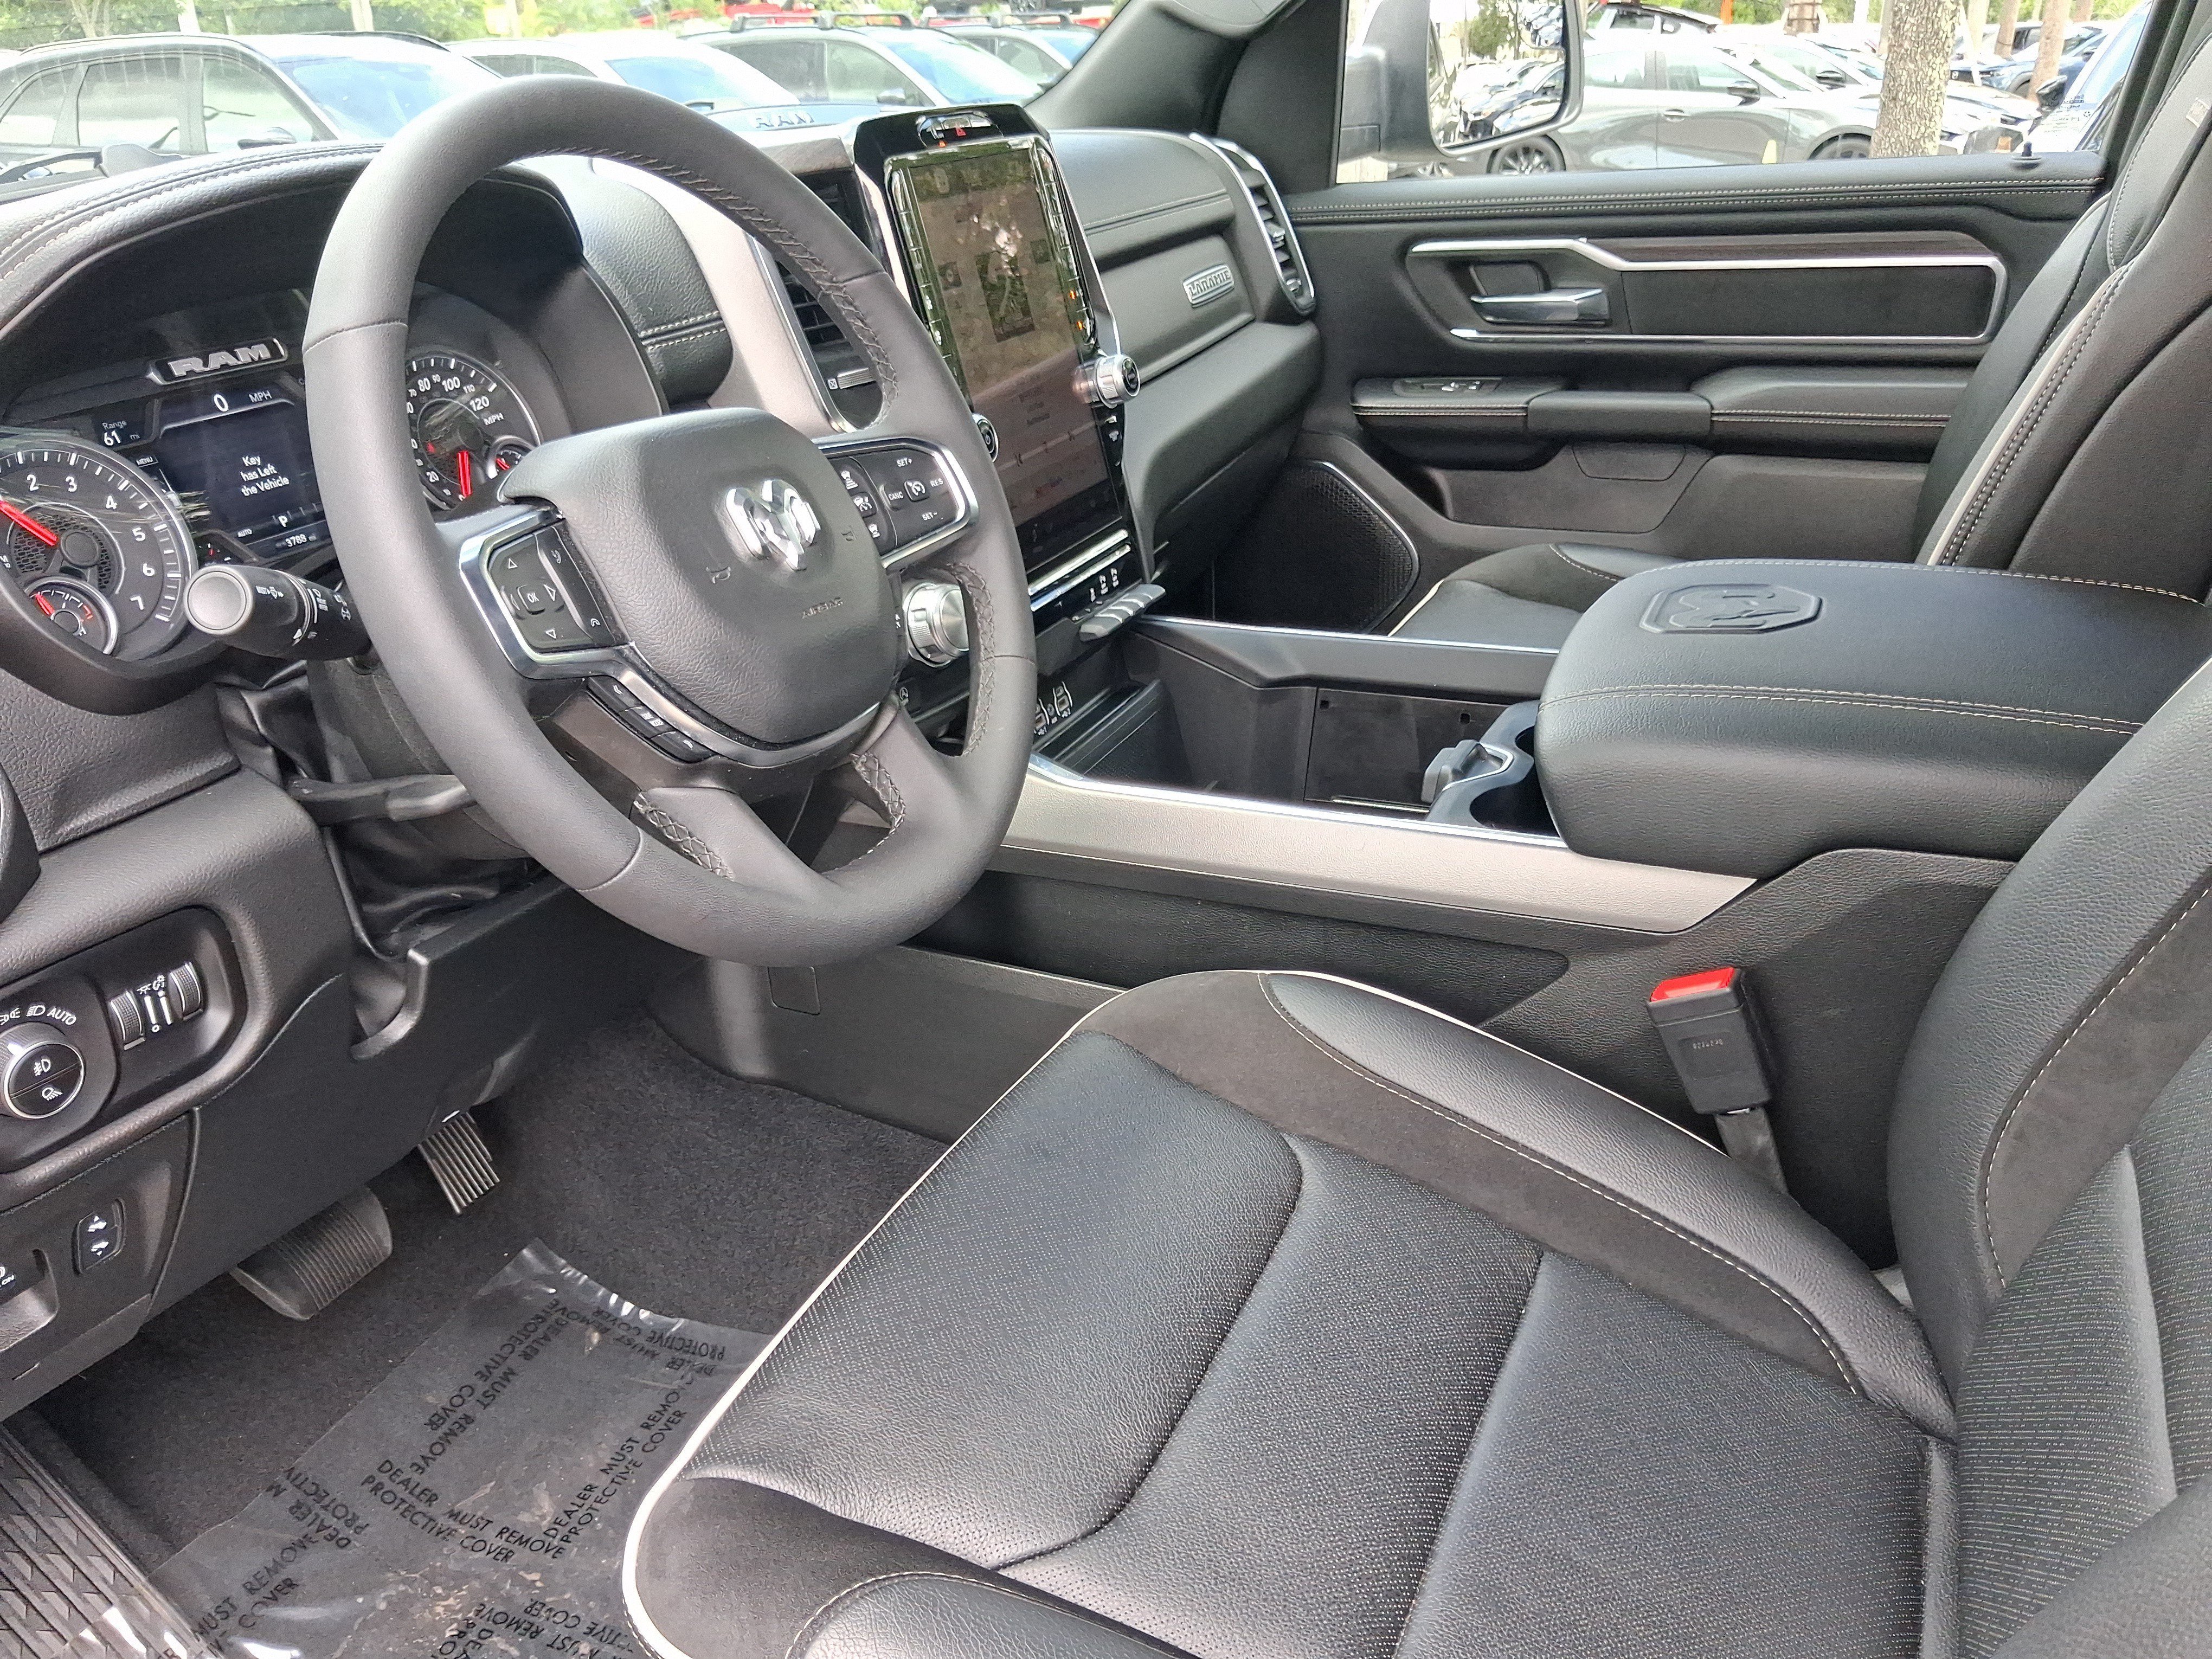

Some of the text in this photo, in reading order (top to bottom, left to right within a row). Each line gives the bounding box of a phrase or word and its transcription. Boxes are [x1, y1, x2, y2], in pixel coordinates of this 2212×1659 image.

[1188, 270, 1231, 295] LARAMIE
[167, 344, 271, 377] RAM
[417, 378, 431, 392] 80
[442, 376, 460, 391] 100
[463, 384, 475, 394] 110
[214, 390, 272, 412] 0 MPH
[470, 395, 490, 411] 120
[102, 420, 127, 430] Range
[484, 413, 504, 425] MPH
[104, 430, 121, 446] 61
[136, 456, 153, 466] MENU
[242, 455, 261, 467] Key
[240, 464, 278, 481] has Left
[426, 471, 439, 482] 20
[27, 474, 39, 491] 2
[66, 476, 78, 492] 3
[241, 476, 290, 496] the Vehicle
[930, 478, 943, 487] RES
[106, 496, 118, 510] 4
[889, 491, 903, 500] CANC
[278, 516, 288, 527] P
[132, 528, 146, 542] 5
[237, 529, 252, 537] AUTO
[143, 563, 155, 576] 6
[130, 596, 144, 610] 7
[528, 593, 539, 603] OK
[47, 1007, 77, 1026] AUTO
[645, 1329, 725, 1361] PROTECTIVE
[477, 1367, 518, 1410] MUST
[423, 1385, 474, 1431] COVER
[409, 1413, 475, 1476] REMOVE
[561, 1410, 687, 1544] PROTECTIVE COVER
[543, 1484, 598, 1539] DEALER
[600, 1437, 639, 1475] MUST
[377, 1459, 566, 1559] DEALER MUST REMOVE
[361, 1475, 516, 1564] PROTECTIVE COVER
[242, 1533, 319, 1595] REMOVE
[239, 1578, 300, 1628] COVER
